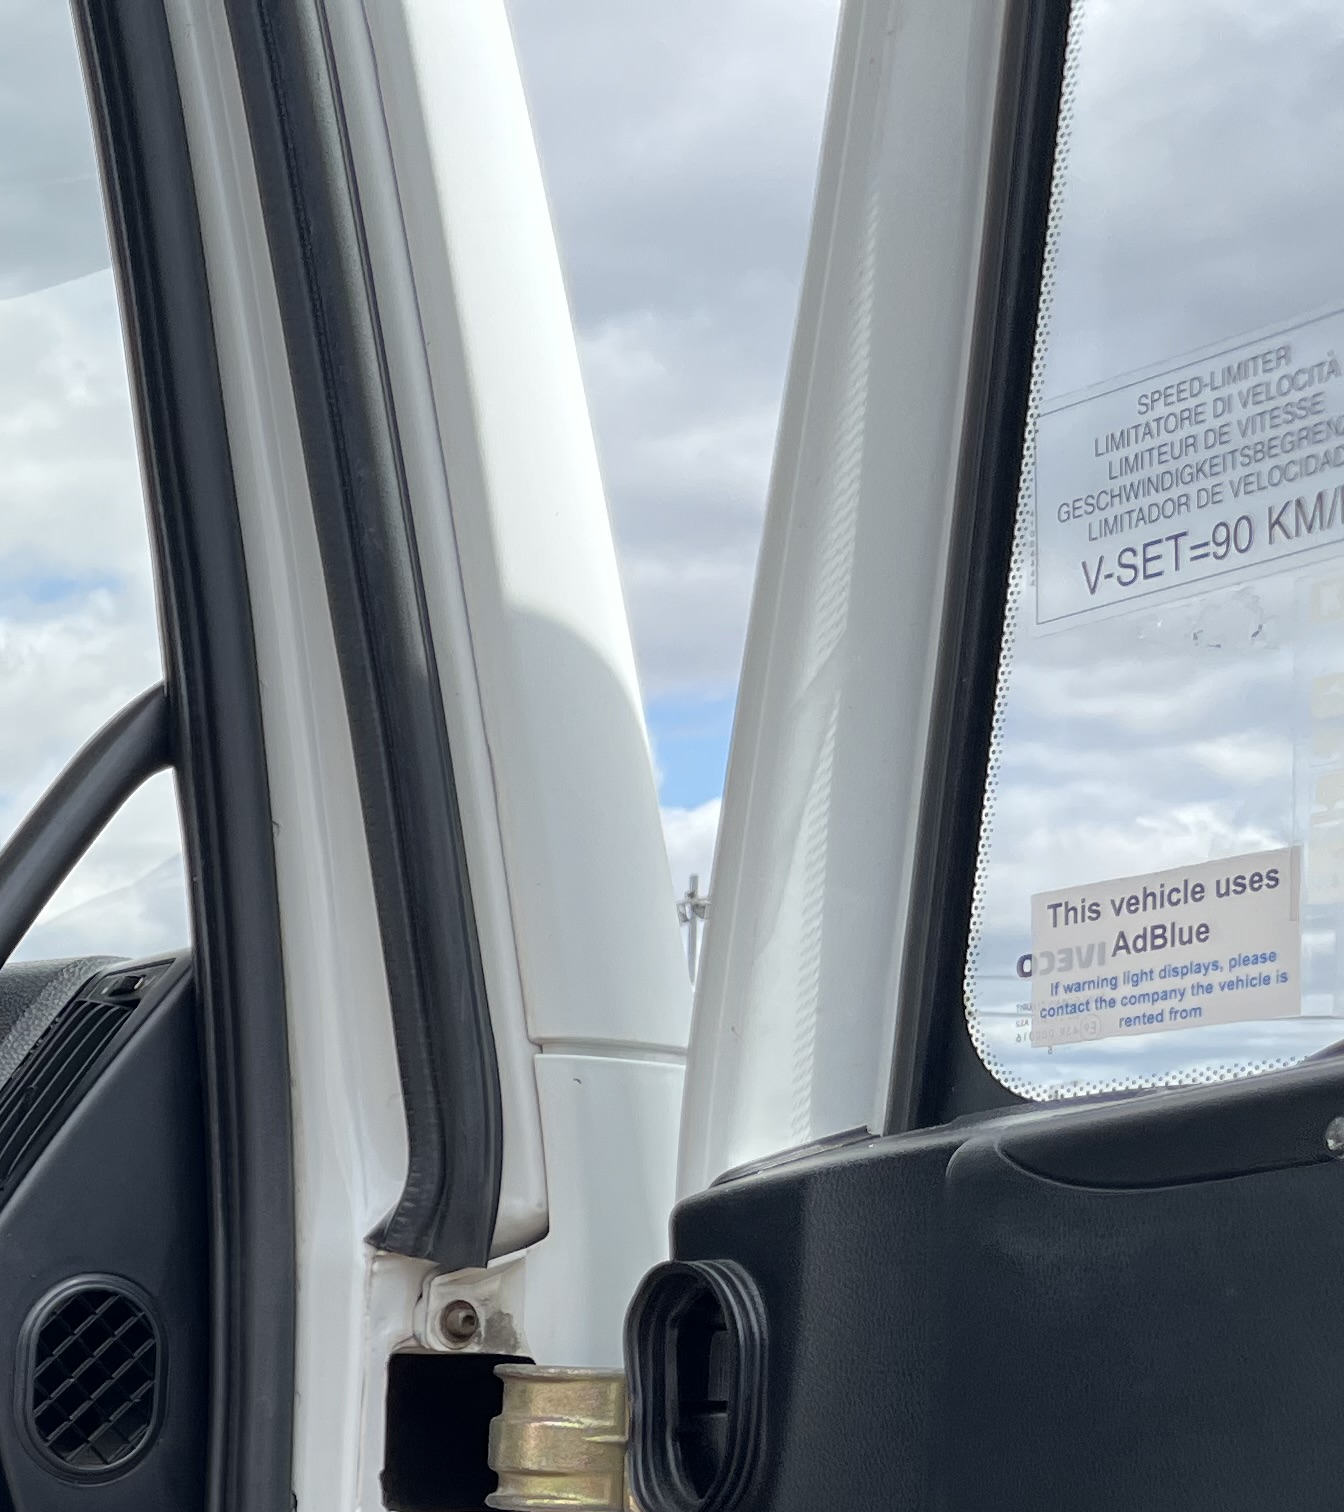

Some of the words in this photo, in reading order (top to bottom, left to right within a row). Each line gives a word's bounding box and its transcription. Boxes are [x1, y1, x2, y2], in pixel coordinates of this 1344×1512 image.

[1137, 344, 1292, 415] SPEED-LIMITER
[1094, 402, 1208, 458] LIMITATORE
[1212, 393, 1233, 419] DI
[1108, 434, 1198, 481] LIMITEUR
[1204, 422, 1232, 450] DE
[1237, 391, 1326, 439] VITESSE
[1081, 514, 1255, 596] V-SET=90
[1267, 484, 1344, 546] KM/
[1088, 493, 1191, 541] LIMITADOR
[1197, 481, 1224, 509] DE
[1046, 897, 1101, 929] This
[1110, 878, 1205, 917] vehicle
[1215, 868, 1280, 899] uses
[1111, 921, 1210, 958] AdBlue
[1040, 1001, 1090, 1019] contact
[1094, 996, 1116, 1011] the
[1120, 987, 1186, 1007] company
[1191, 981, 1214, 997] the
[1219, 973, 1271, 992] vehicle
[1275, 969, 1289, 984] is
[1050, 981, 1060, 997] If
[1063, 975, 1118, 995] warning
[1122, 967, 1154, 988] light
[1158, 959, 1224, 980] displays,
[1228, 951, 1277, 973] please
[1119, 1009, 1164, 1028] rented
[1169, 1006, 1202, 1021] from
